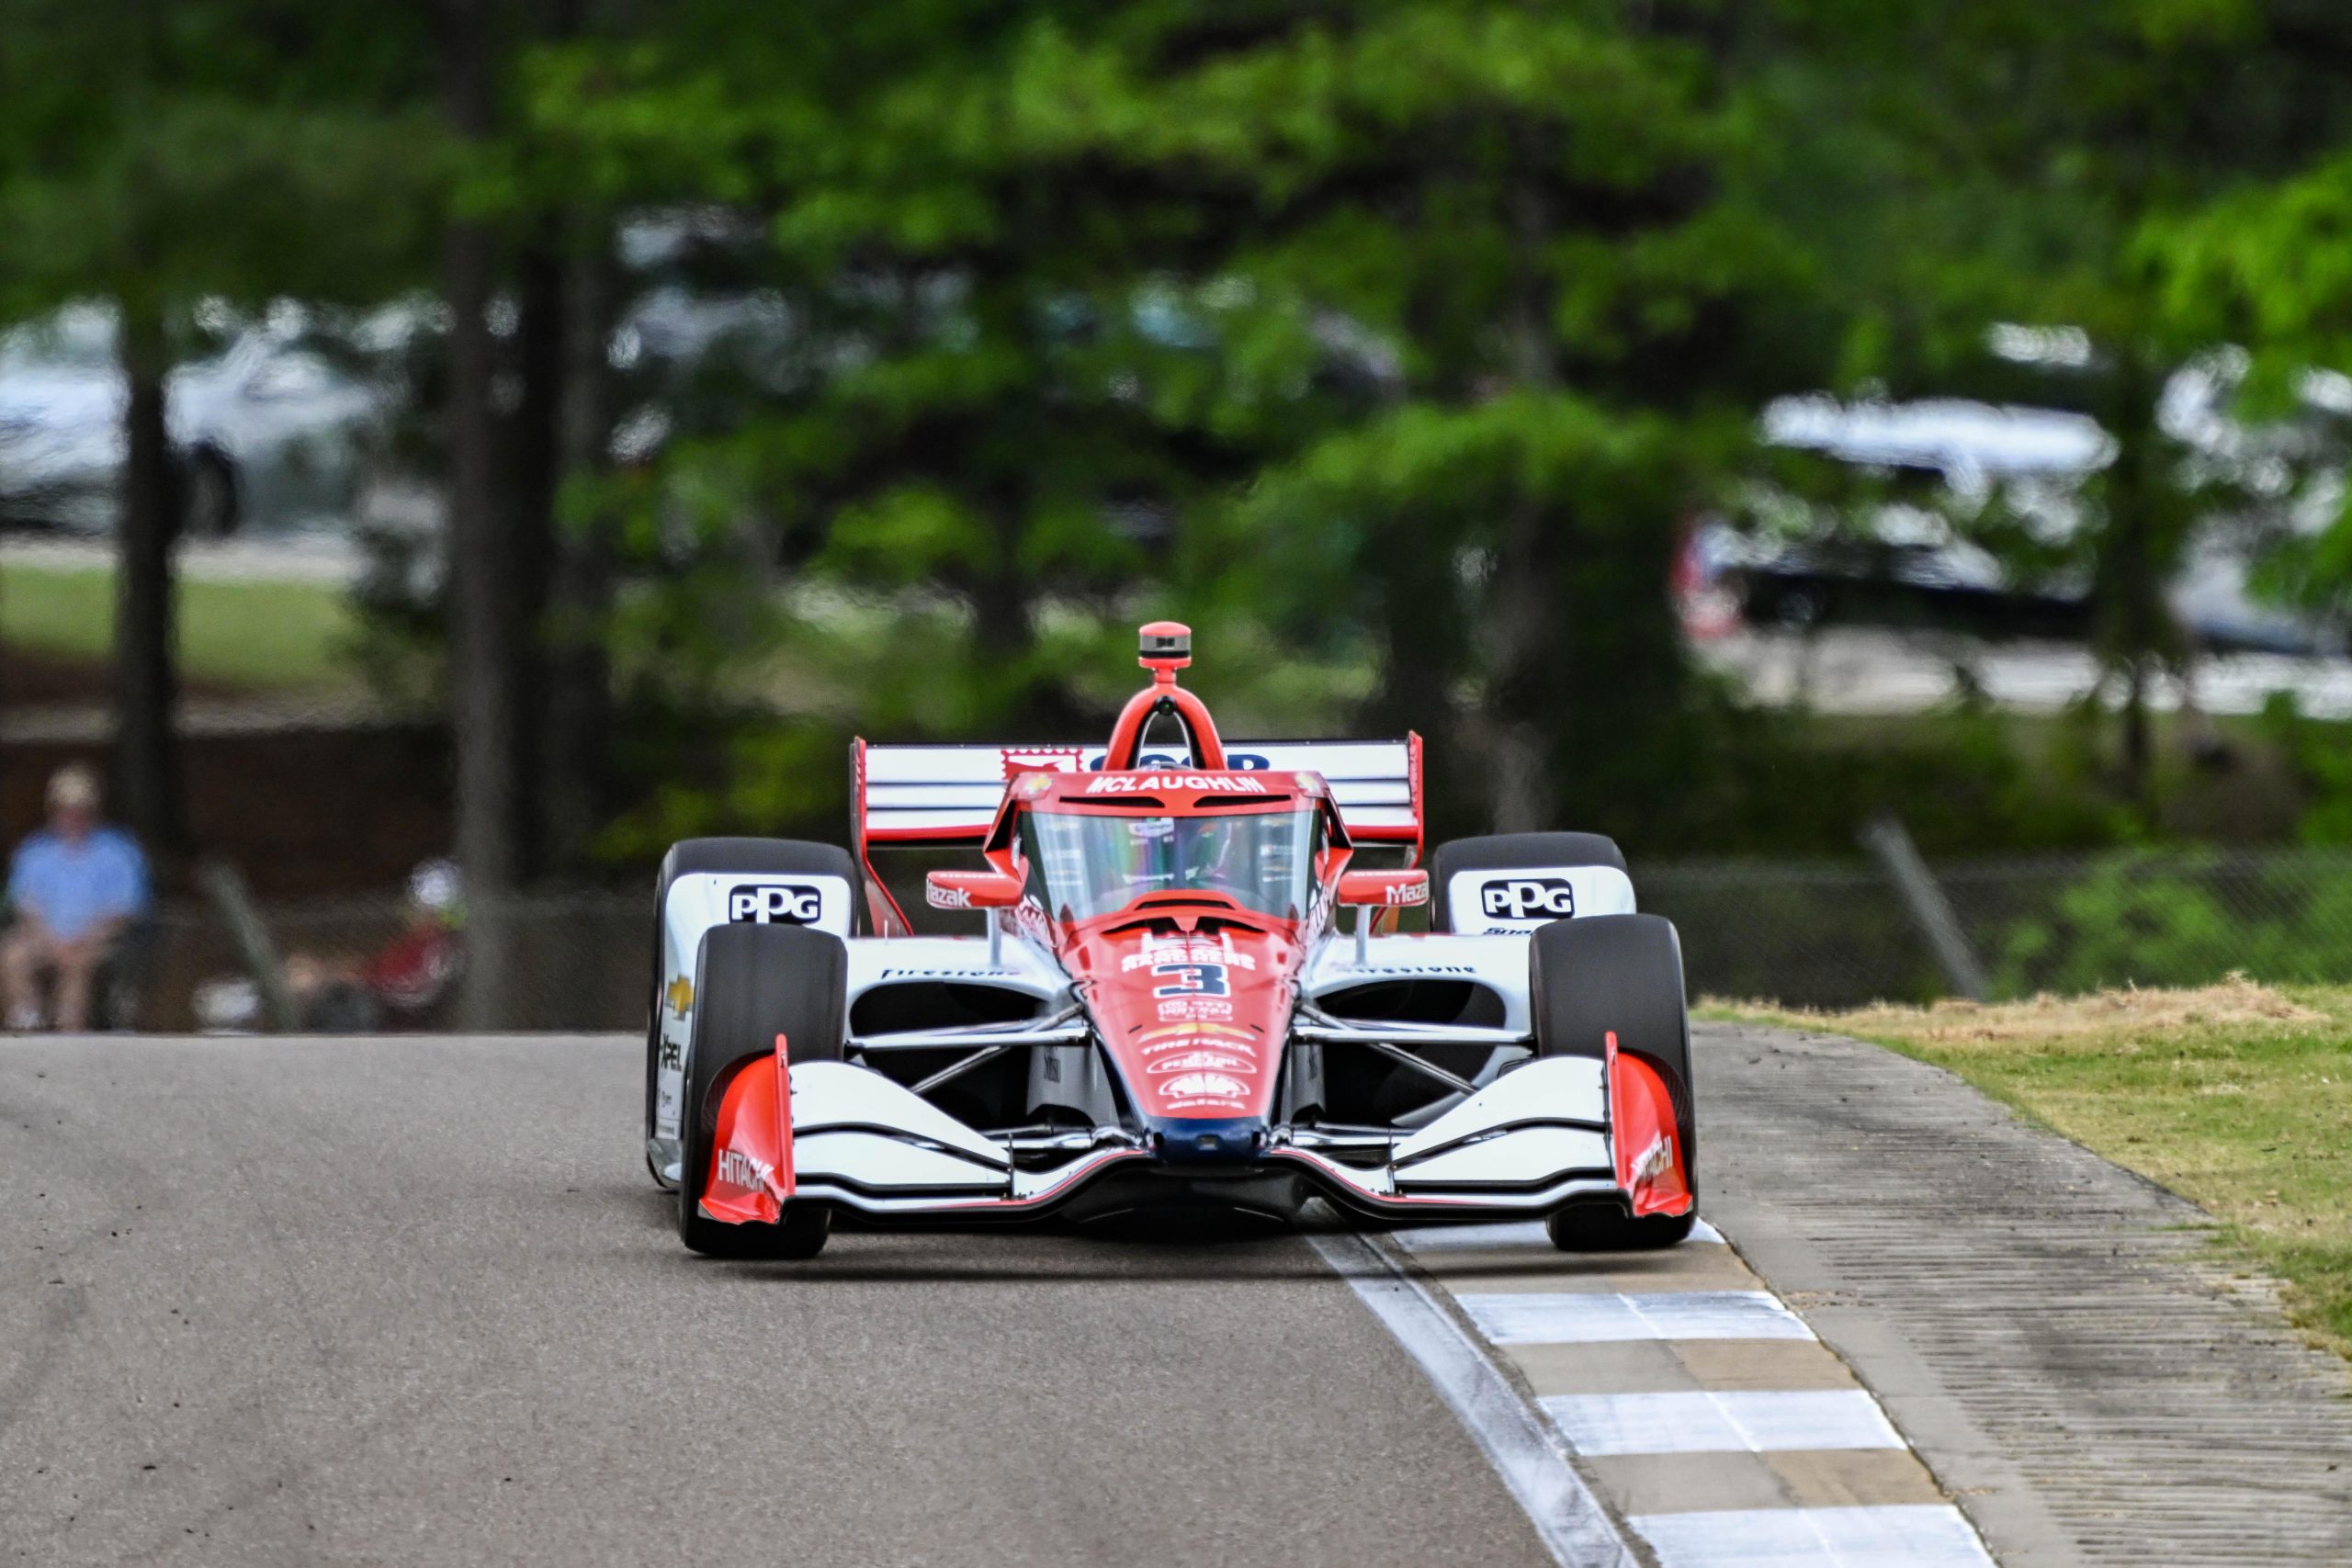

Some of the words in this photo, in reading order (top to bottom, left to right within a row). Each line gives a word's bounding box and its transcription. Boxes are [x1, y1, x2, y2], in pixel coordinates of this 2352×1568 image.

[1085, 775, 1267, 794] MCLAUGHLIN
[731, 887, 819, 924] PPG
[1484, 881, 1572, 919] PPG
[1151, 964, 1231, 998] 3
[718, 1148, 775, 1193] HITACHI
